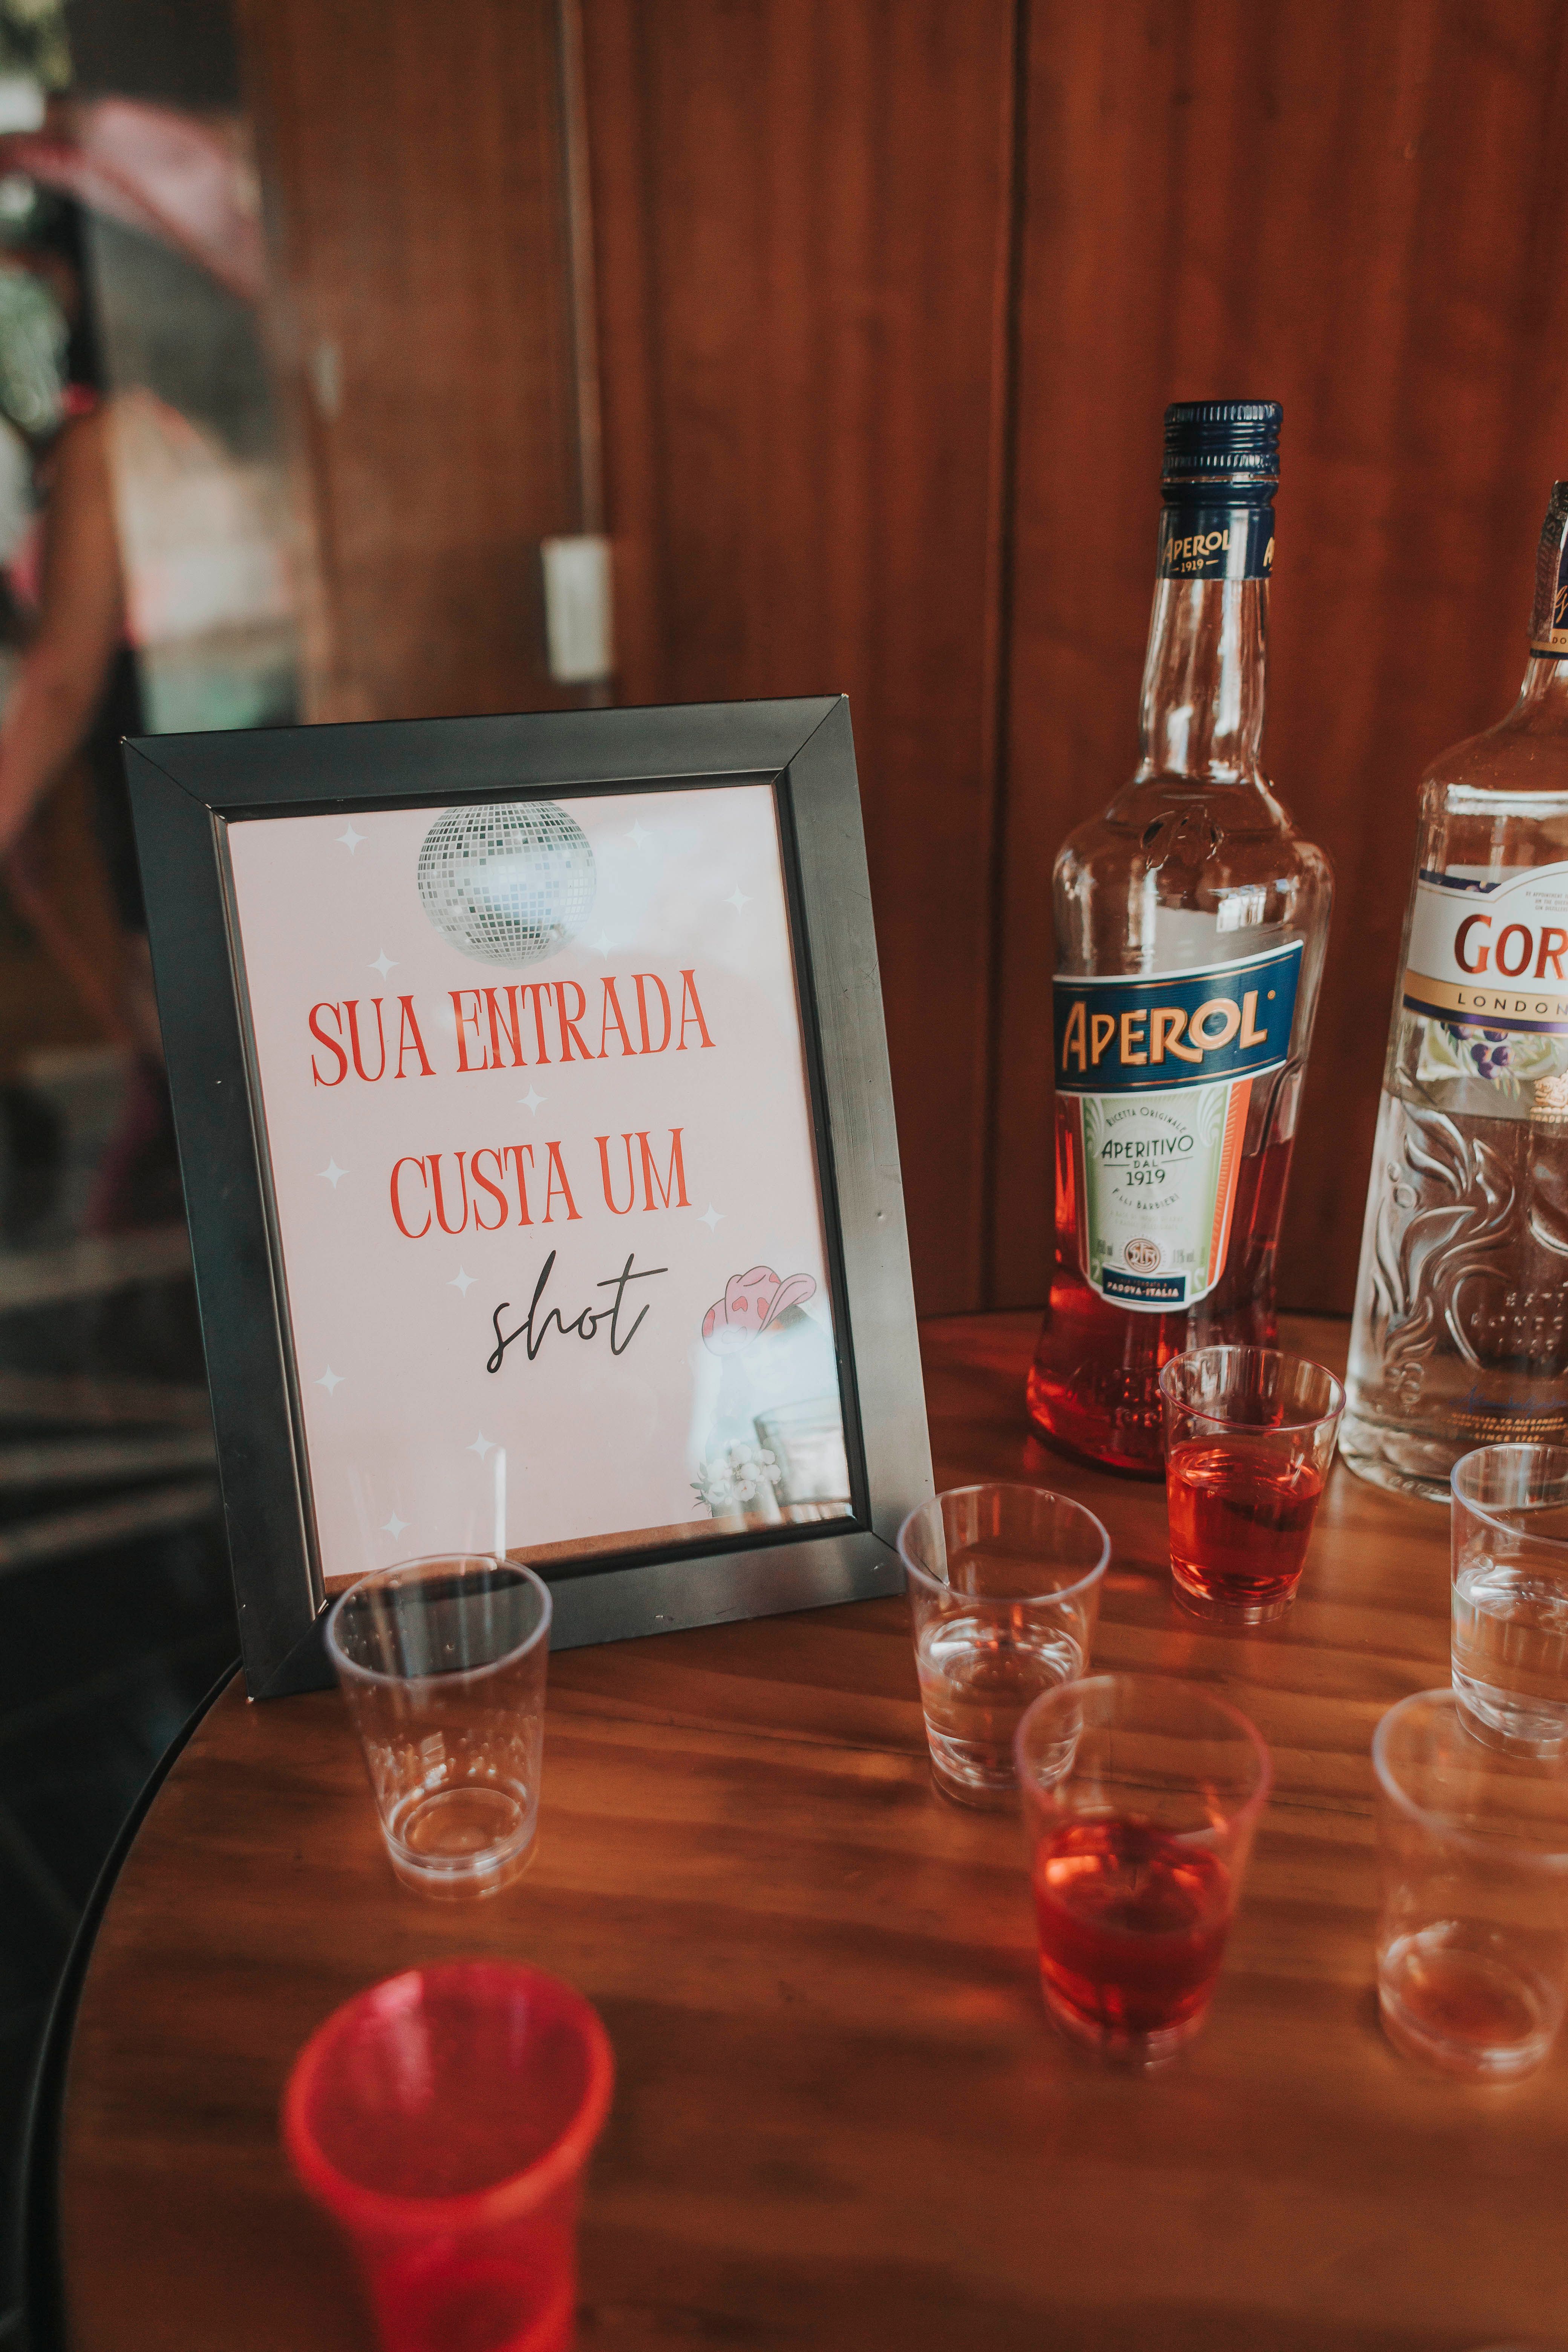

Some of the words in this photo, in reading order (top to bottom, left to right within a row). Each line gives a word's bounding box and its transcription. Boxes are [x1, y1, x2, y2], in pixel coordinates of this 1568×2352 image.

[1162, 529, 1231, 565] APEROL
[1458, 992, 1568, 1015] LONDON
[308, 995, 436, 1087] SUA
[448, 969, 716, 1073] ENTRADA
[1106, 1108, 1136, 1127] RICETTA
[1140, 1107, 1187, 1133] ORIGINALE
[1101, 1134, 1194, 1158] APERITIVO
[1133, 1159, 1158, 1168] DAL
[390, 1141, 583, 1239] CUSTA
[594, 1127, 691, 1215] UM
[1126, 1169, 1165, 1185] 1919
[1137, 1193, 1179, 1210] BARBIERI
[487, 1250, 668, 1374] shot
